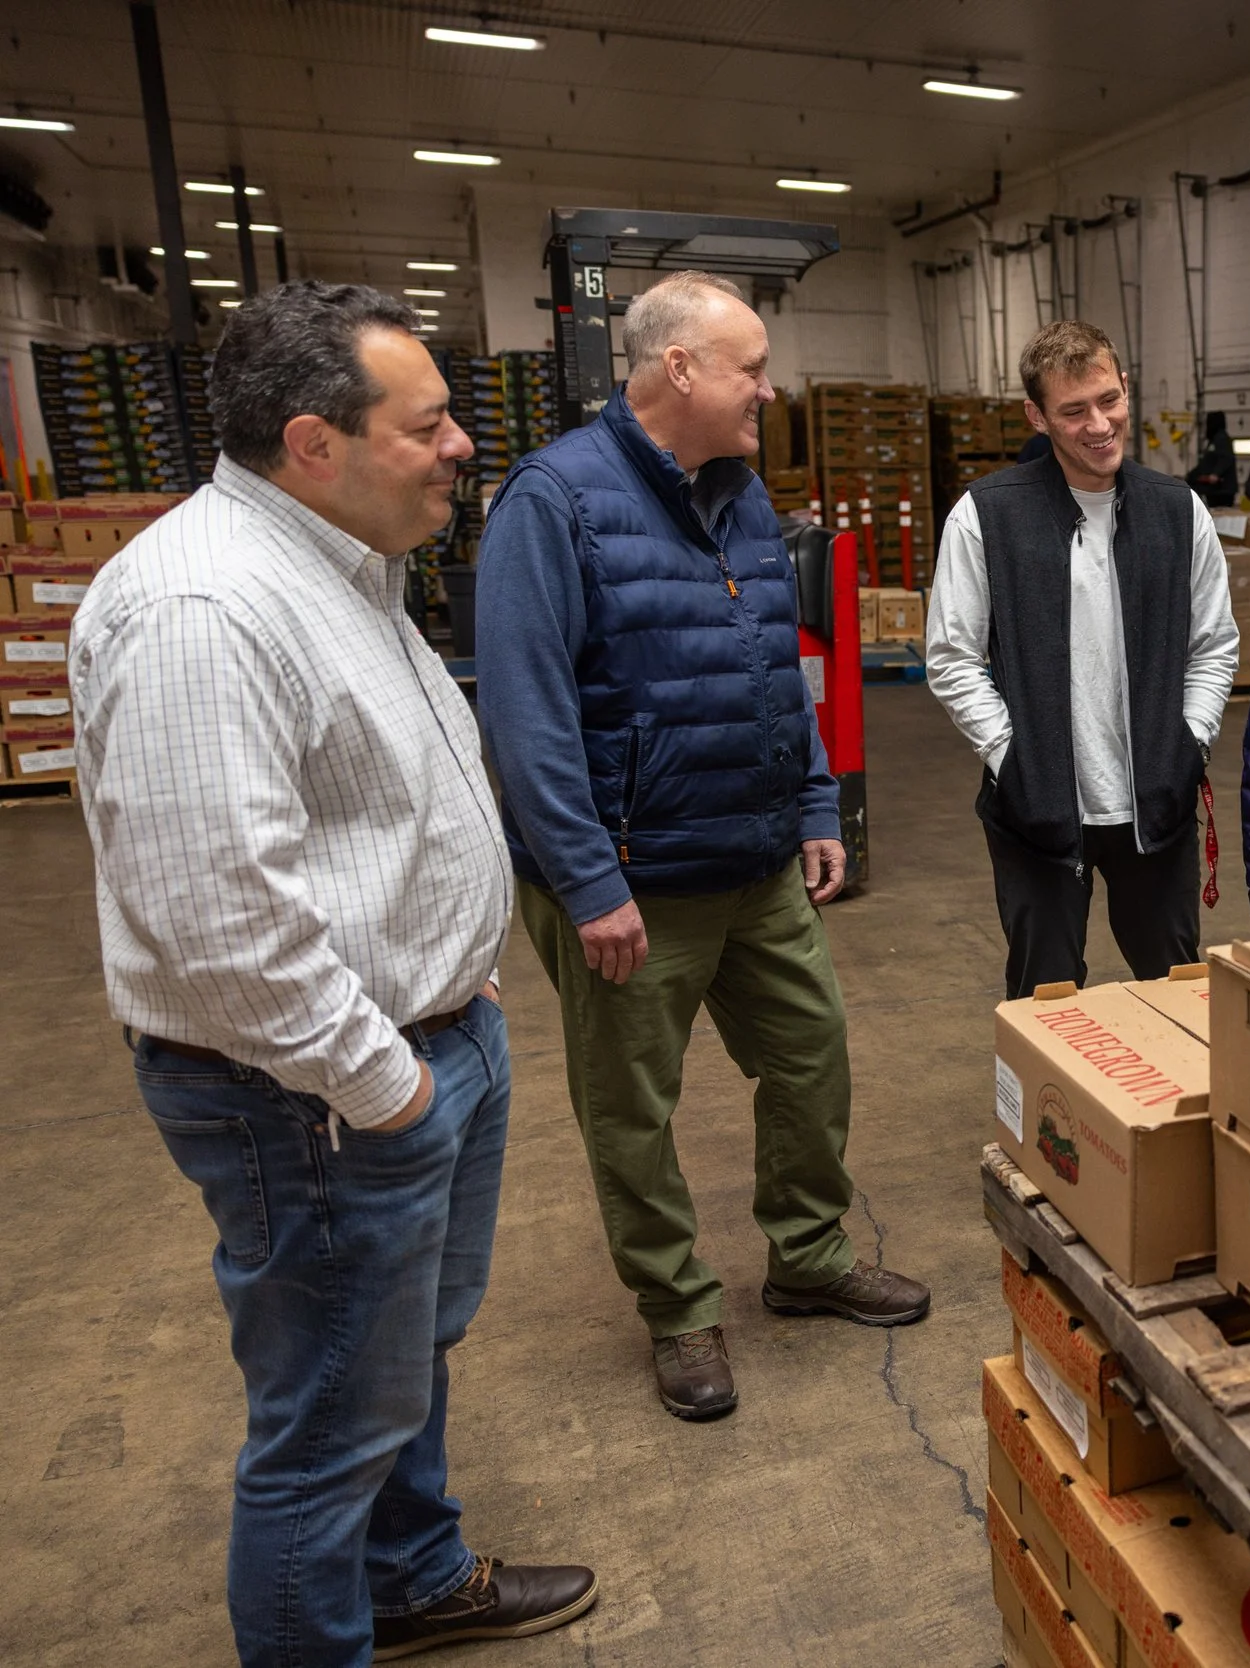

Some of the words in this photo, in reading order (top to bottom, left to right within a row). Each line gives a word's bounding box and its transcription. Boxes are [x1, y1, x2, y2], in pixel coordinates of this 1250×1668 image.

[589, 268, 601, 295] 5
[1034, 1007, 1185, 1107] HOMEGROWN
[1078, 1120, 1128, 1175] TOMATOES
